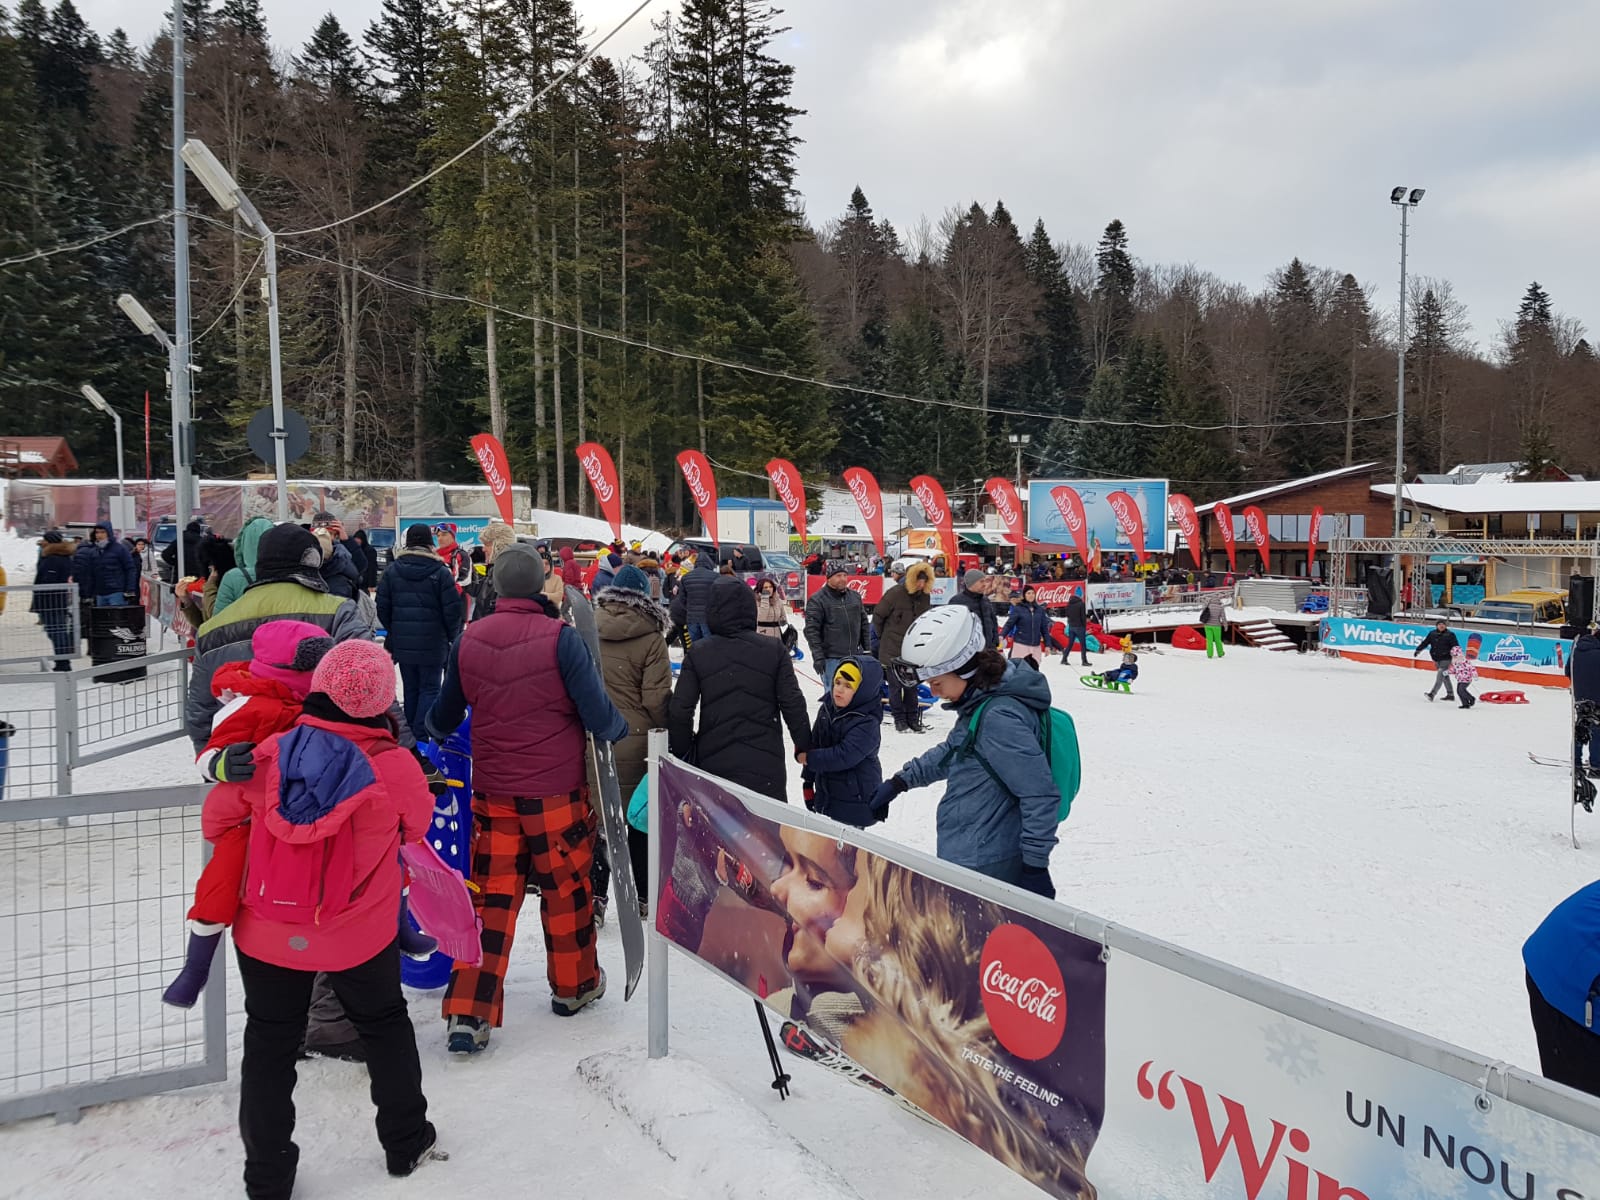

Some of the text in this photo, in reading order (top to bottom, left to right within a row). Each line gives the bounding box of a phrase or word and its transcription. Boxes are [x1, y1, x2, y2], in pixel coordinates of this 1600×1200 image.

[1343, 623, 1425, 647] WinterKis
[982, 960, 1062, 1023] Coca-Cola
[961, 1047, 994, 1070] TASTE
[993, 1063, 1014, 1083] THE
[1345, 1090, 1535, 1200] UN NOU
